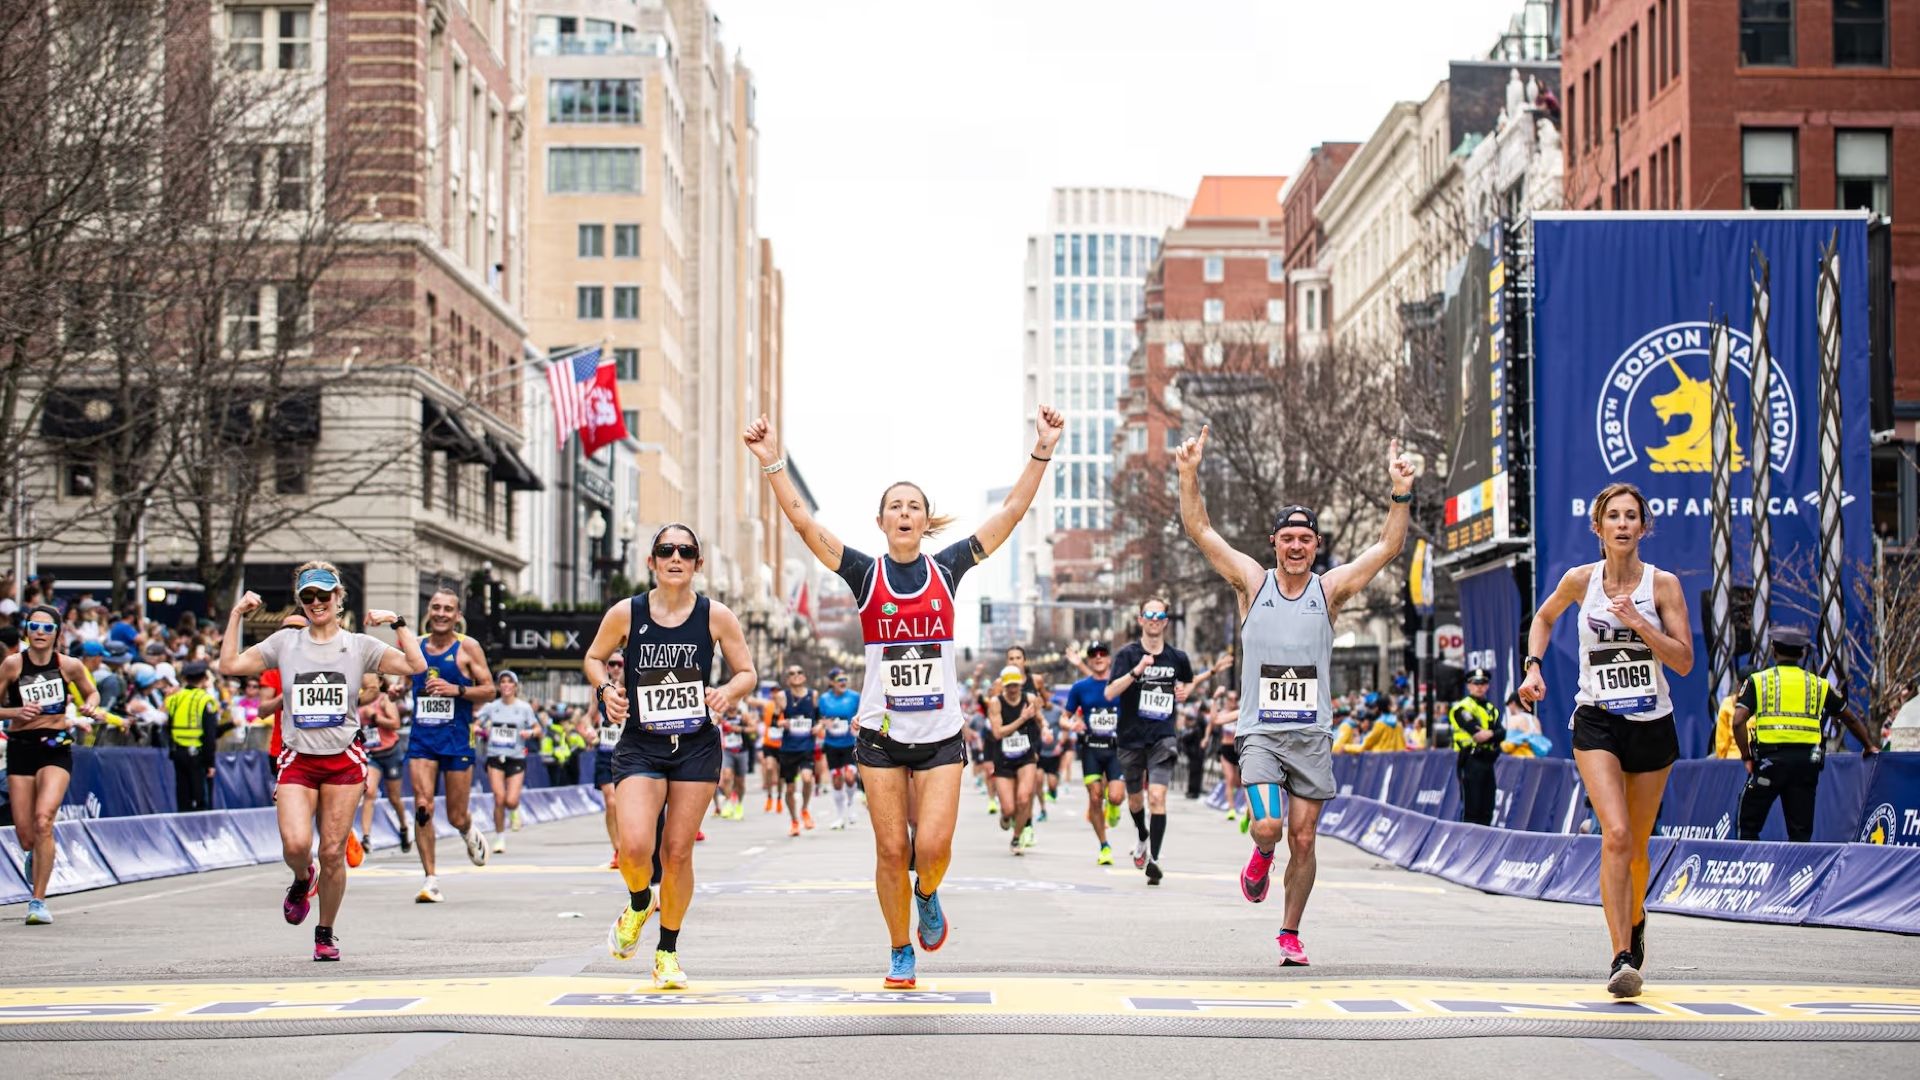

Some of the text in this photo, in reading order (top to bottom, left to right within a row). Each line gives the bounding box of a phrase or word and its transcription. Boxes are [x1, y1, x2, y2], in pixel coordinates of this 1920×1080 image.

[1604, 328, 1790, 463] 128TH BOSTON AATHON
[1649, 496, 1799, 516] OF AERCA
[877, 616, 946, 638] ITALIA
[509, 630, 580, 649] LENOX
[638, 643, 698, 669] NAVY
[890, 663, 933, 687] 9517
[1596, 664, 1652, 691] 15069
[25, 682, 59, 702] 15131
[298, 687, 343, 707] 13445
[644, 685, 699, 712] 12253
[1143, 693, 1171, 708] 11427
[1269, 681, 1307, 702] 8141
[421, 699, 451, 713] 10353
[1701, 859, 1727, 884] THE
[1722, 860, 1775, 886] BOSTON
[1685, 886, 1761, 912] MARATHON
